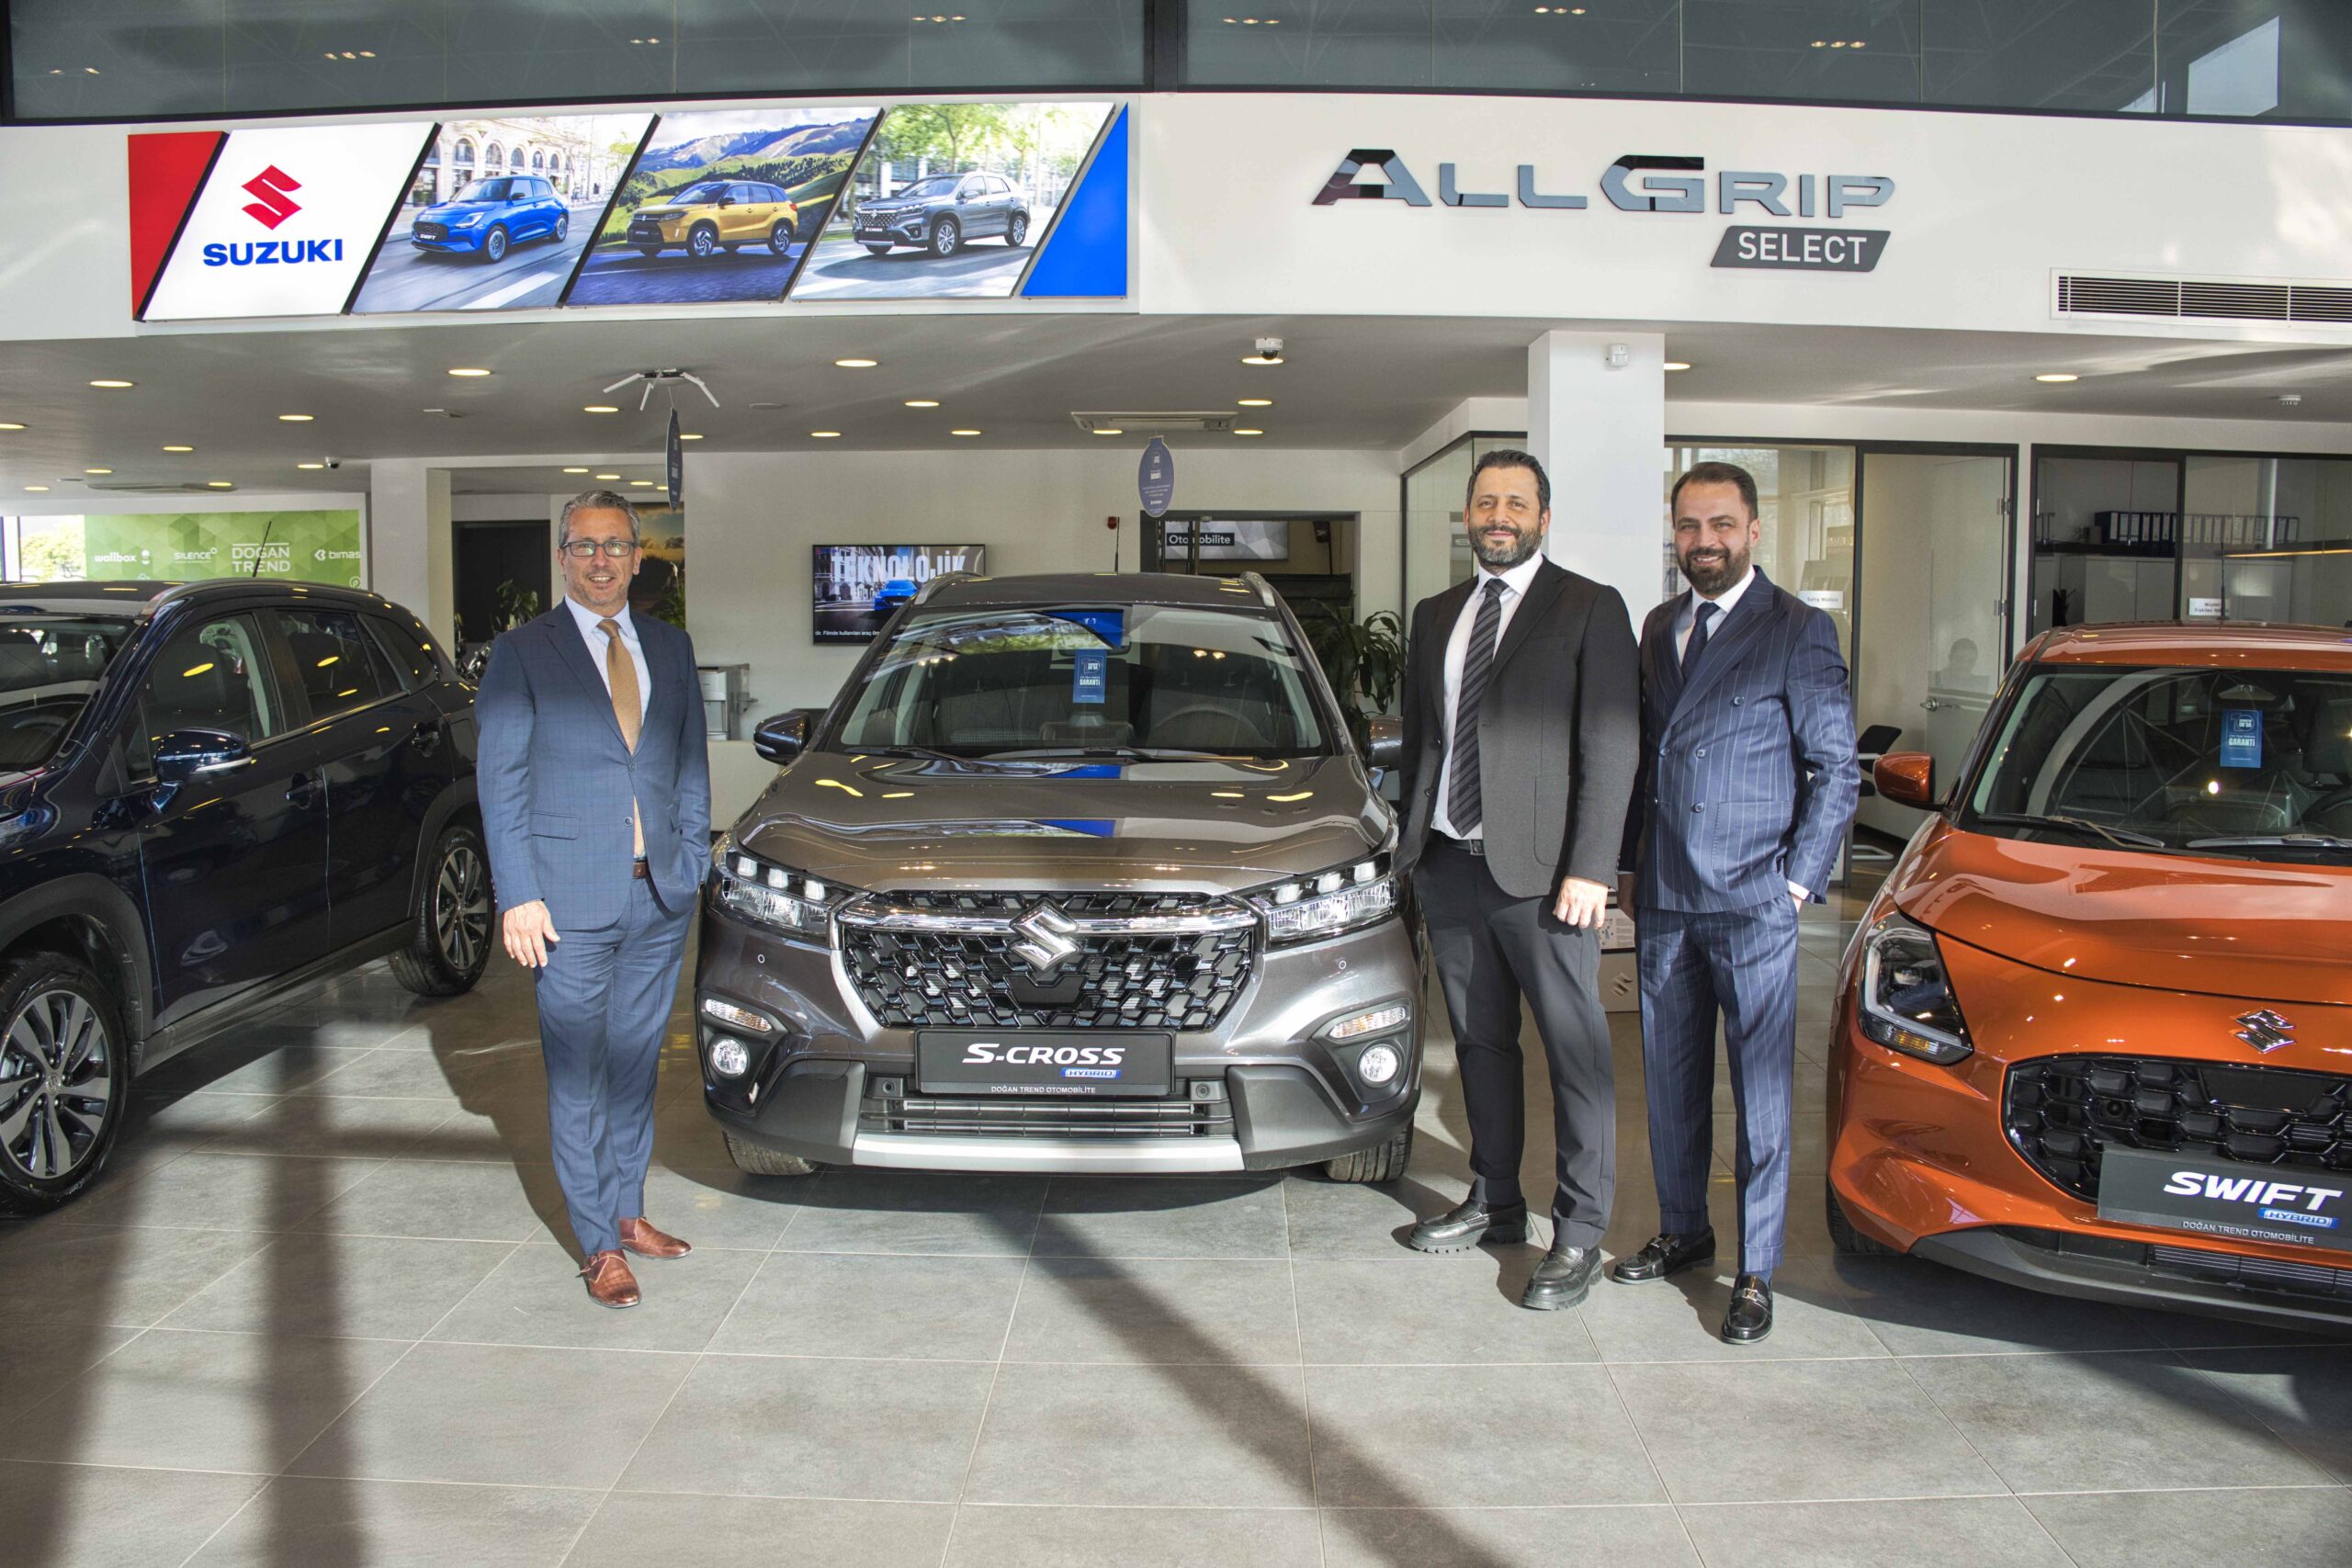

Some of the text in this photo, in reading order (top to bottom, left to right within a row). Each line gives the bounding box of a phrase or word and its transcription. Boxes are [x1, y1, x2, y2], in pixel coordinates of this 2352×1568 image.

[203, 239, 343, 266] SUZUKI
[1737, 231, 1868, 265] SELECT
[1169, 534, 1231, 545] Otoobilite
[95, 552, 137, 562] wallbox
[232, 560, 291, 573] TREND
[962, 1043, 1125, 1066] S-CROSS
[1068, 1069, 1114, 1077] HYBRID
[990, 1085, 1018, 1093] DOĞAN
[1046, 1086, 1096, 1094] OTOMOBİLİTE
[2163, 1171, 2343, 1211] SWIFT
[2267, 1211, 2330, 1225] HYBRID
[2182, 1220, 2314, 1244] DOĞAN TREND OTOMOBİLİTE
